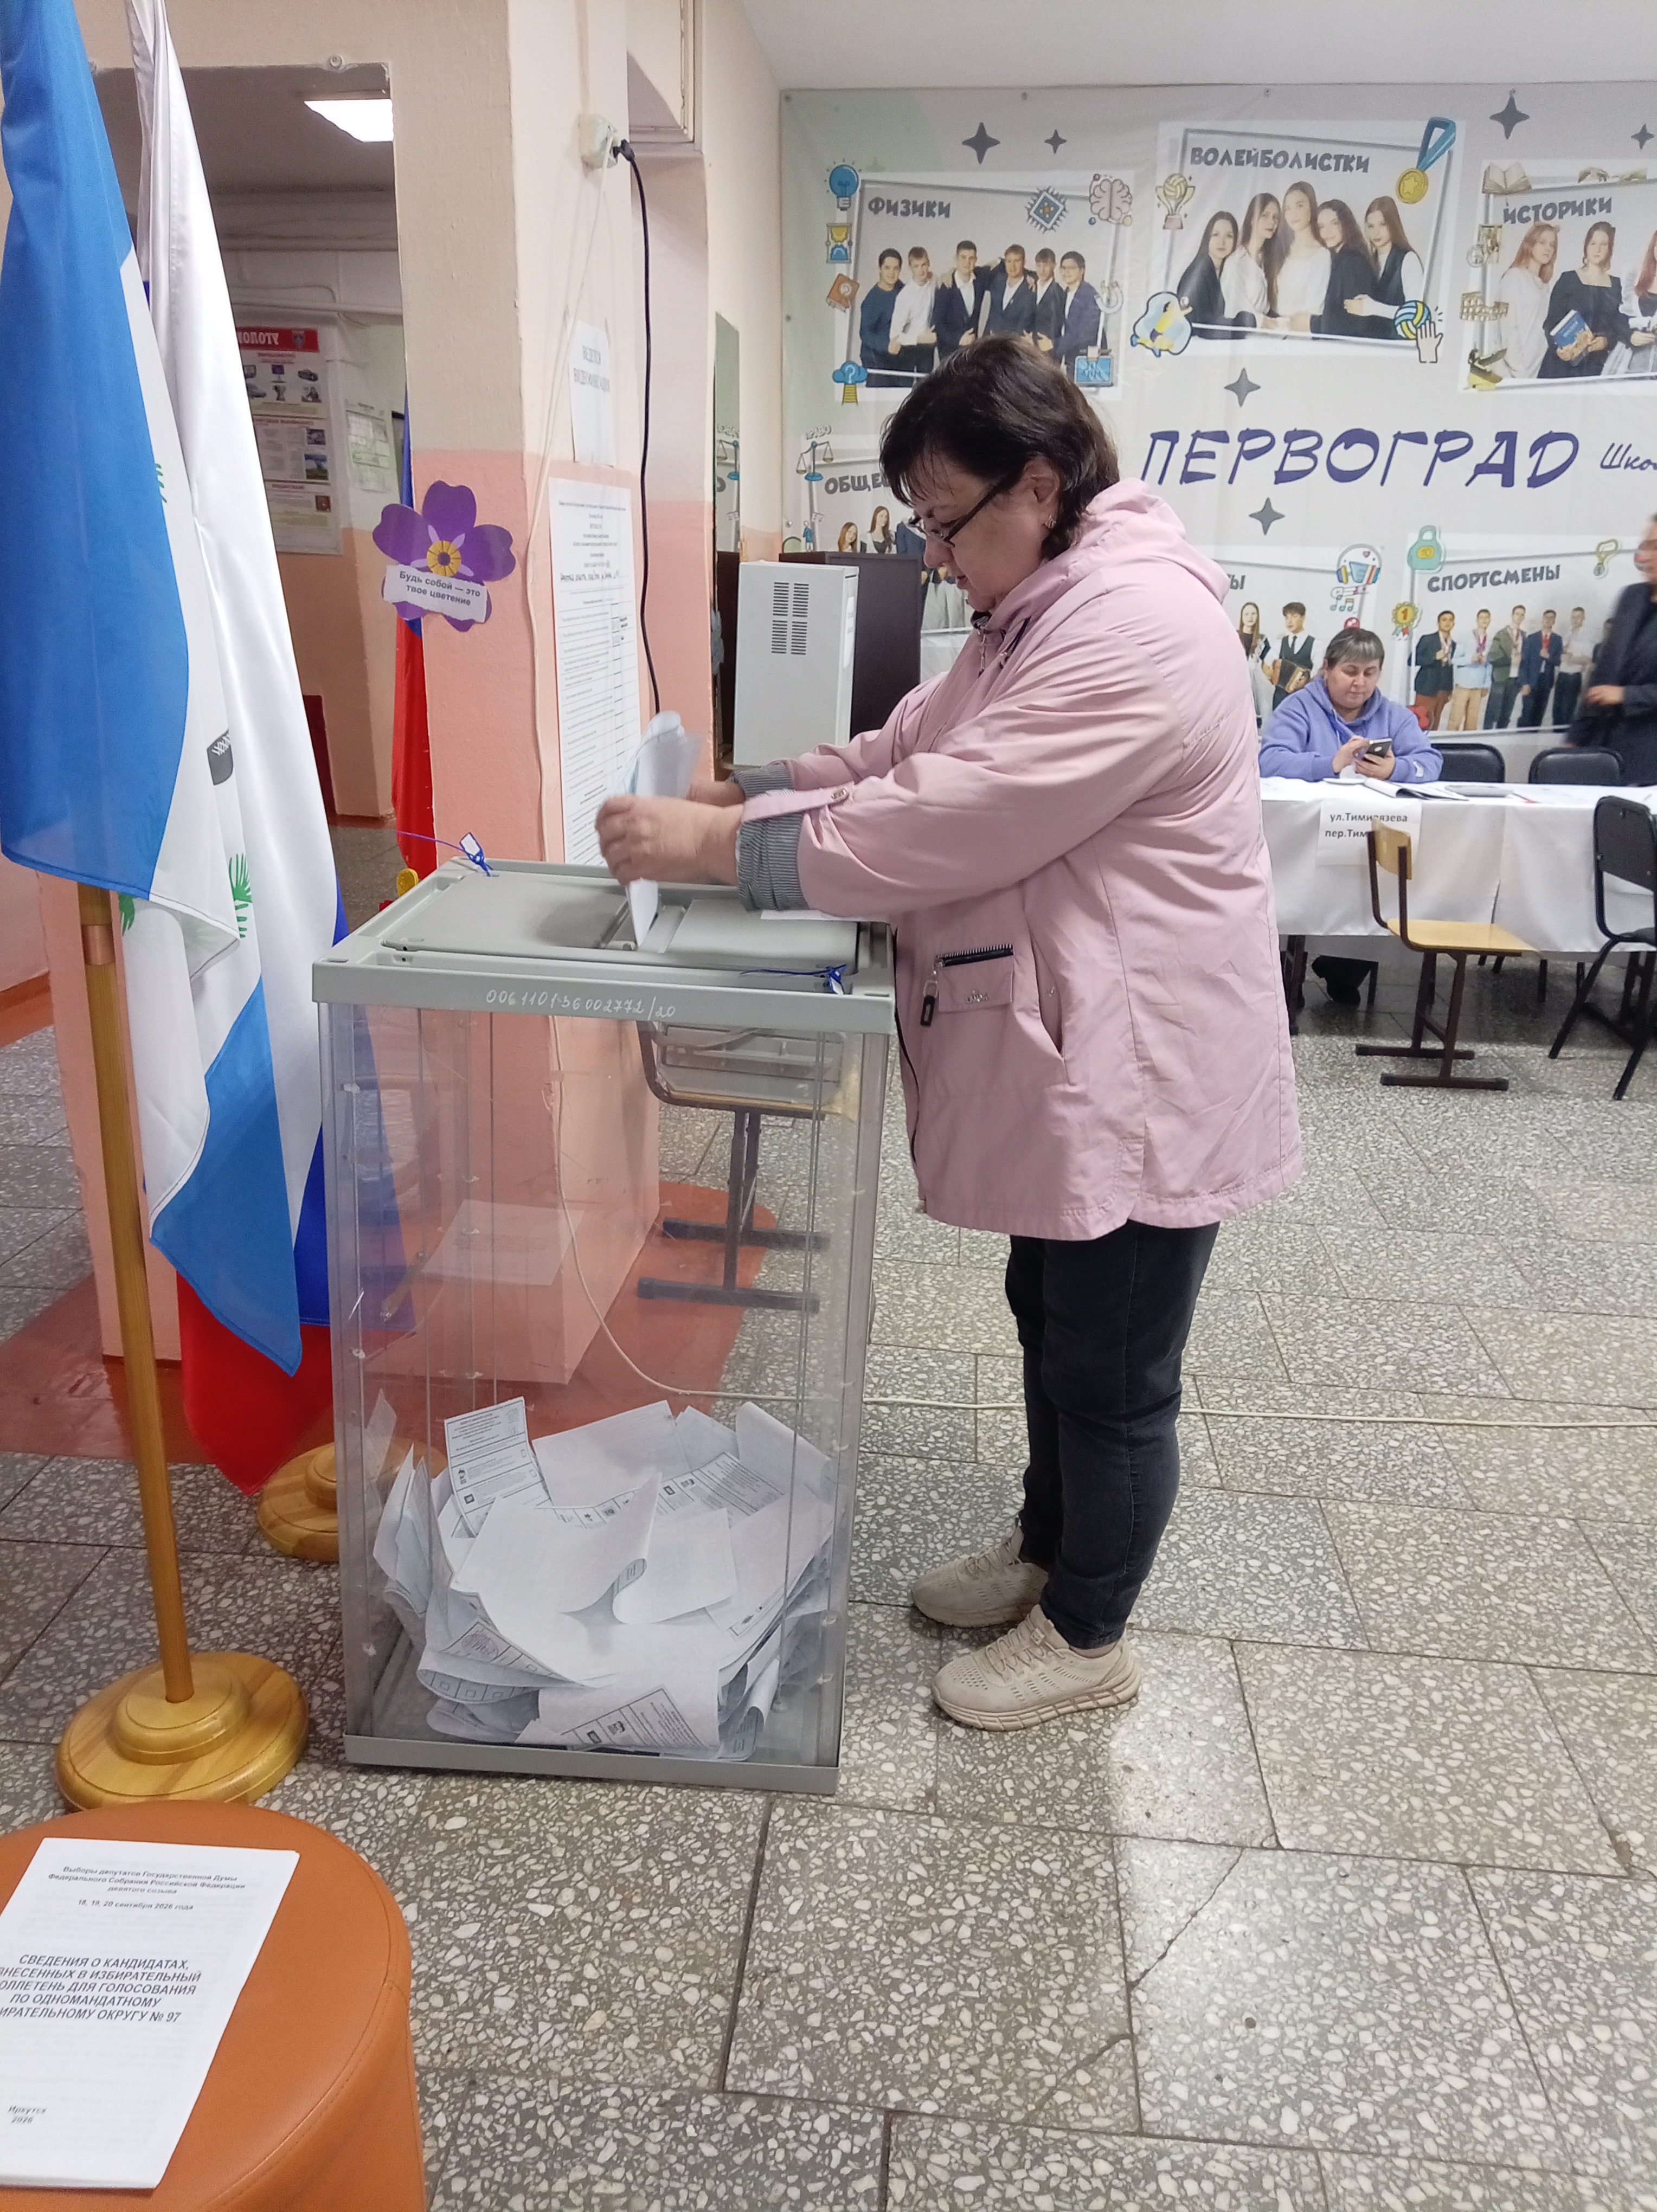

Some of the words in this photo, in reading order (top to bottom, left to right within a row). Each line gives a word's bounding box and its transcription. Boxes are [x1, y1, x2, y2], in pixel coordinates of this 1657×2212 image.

[1190, 147, 1370, 173] ВОЛЕЙБОЛИСТКИ
[868, 196, 951, 218] ФИЗИКИ
[1503, 196, 1612, 224] ИСТОРИКИ
[1141, 428, 1579, 488] ПЕРВОГРАД
[399, 571, 423, 583] Будь
[425, 577, 452, 590] собой
[465, 588, 480, 597] это
[1428, 564, 1560, 593] СПОРТСМЕНЫ
[406, 585, 427, 595] твое
[430, 590, 471, 606] цветение
[1402, 608, 1408, 621] 1
[1325, 829, 1369, 839] пер.Тим
[48, 1874, 107, 1882] Федерального
[63, 1866, 97, 1874] Выборы
[142, 1871, 212, 1880] Государственной
[114, 1901, 153, 1909] сентября
[19, 1954, 89, 1967] СВЕДЕНИЯ
[91, 1958, 101, 1967] О
[103, 1958, 188, 1970] КАНДИДАТАХ,
[77, 1970, 87, 1979] В
[89, 1970, 202, 1982] ИЗБИРАТЕЛЬНЫЙ
[66, 1982, 97, 1993] ДЛЯ
[98, 1983, 197, 1995] ГОЛОСОВАНИЯ
[9, 1994, 30, 2004] ПО
[33, 1994, 162, 2008] ОДНОМАНДАТНОМУ
[0, 2007, 96, 2020] ИРАТЕЛЬНОМУ
[97, 2009, 149, 2022] ОКРУГУ
[149, 2011, 164, 2022] №
[166, 2012, 182, 2022] 97
